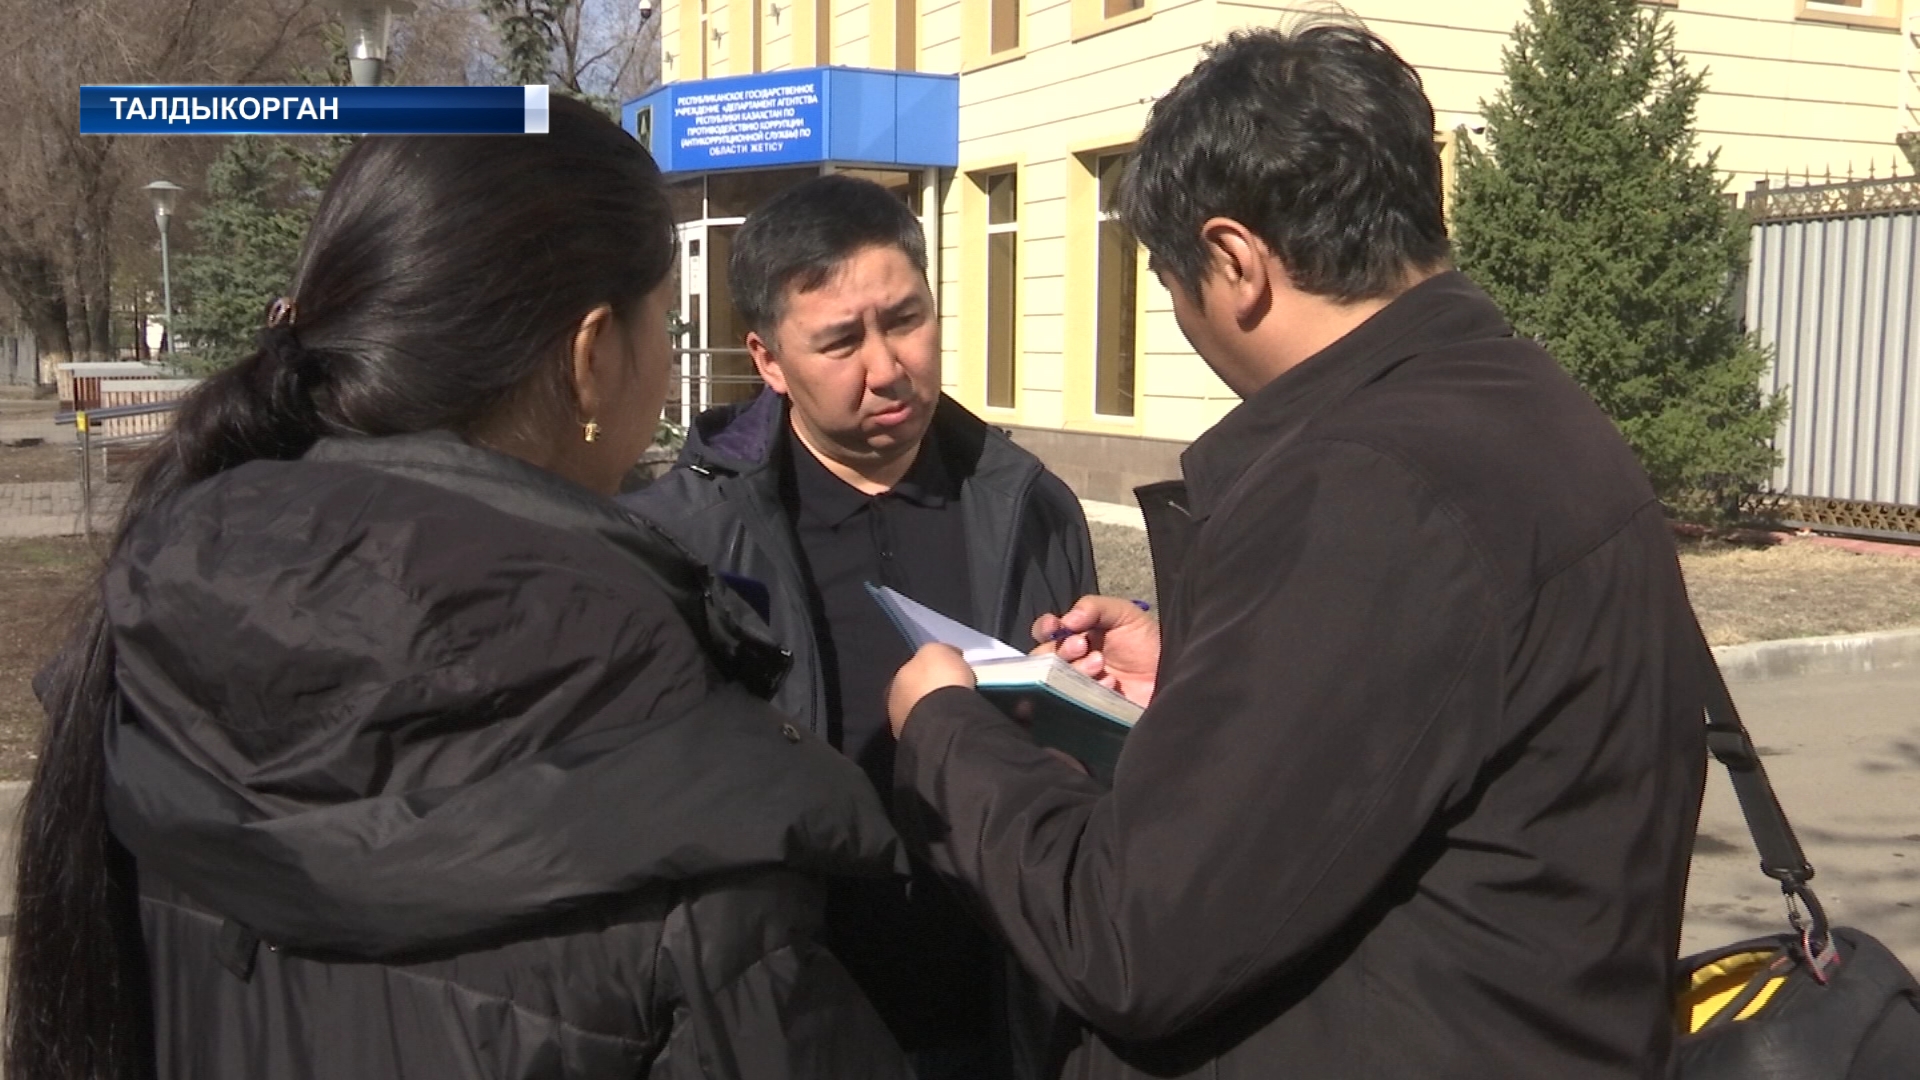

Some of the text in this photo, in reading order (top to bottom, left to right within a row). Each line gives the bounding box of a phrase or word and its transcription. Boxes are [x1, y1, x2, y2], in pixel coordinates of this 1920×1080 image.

[677, 84, 814, 106] РЕСПУБЛИКАНСКОЕ ГОСУДАРСТВЕННОЕ
[674, 104, 719, 117] УЧРЕЖДЕНИЕ
[777, 95, 818, 107] АГЕНТСТВА
[695, 108, 795, 125] РЕСПУБЛИКИ КАЗАХСТАН ПО
[687, 119, 804, 137] ПРОТИВОДЕЙСТВИЮ КОРРУПЦИИ
[799, 128, 811, 138] ПО
[708, 145, 748, 157] ОБЛАСТИ
